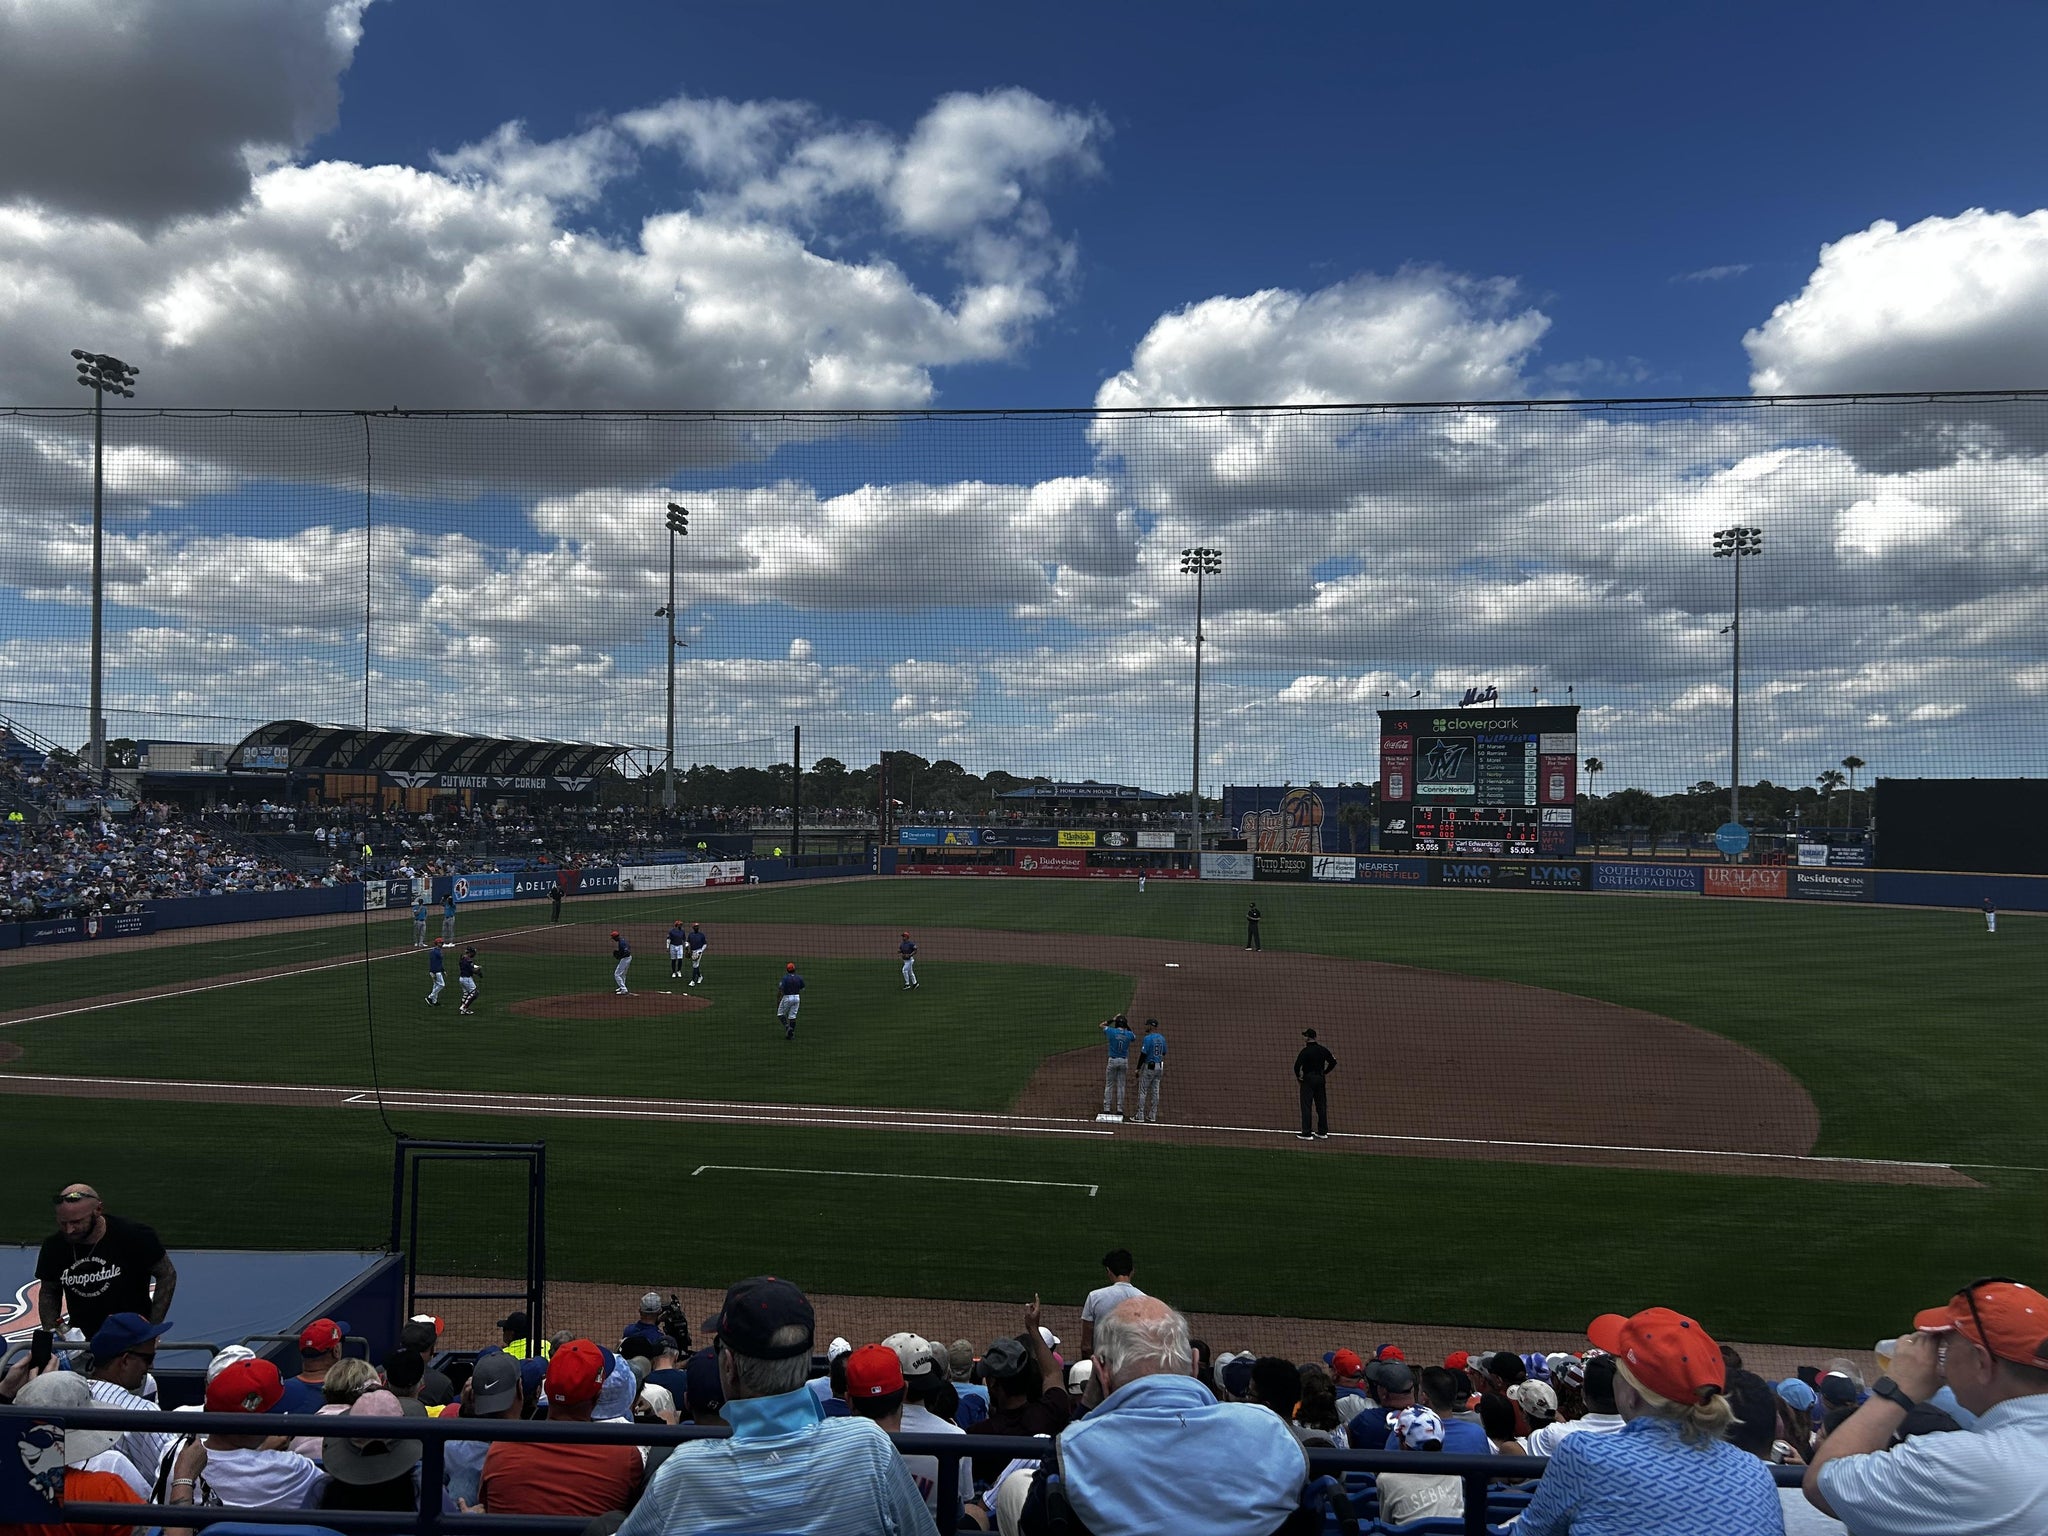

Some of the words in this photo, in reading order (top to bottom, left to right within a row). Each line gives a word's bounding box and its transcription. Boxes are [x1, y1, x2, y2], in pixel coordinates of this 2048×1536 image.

[1458, 685, 1498, 707] Mets
[441, 775, 488, 788] CUTWATER
[515, 776, 546, 789] CORNER
[1449, 812, 1455, 820] 0
[1499, 813, 1505, 821] 2
[1258, 829, 1311, 852] Mets
[1415, 843, 1439, 851] $5,055
[1510, 846, 1535, 854] $5,055
[1039, 856, 1081, 866] Budweiser
[1255, 856, 1279, 868] TUTTO
[1279, 857, 1306, 869] FRESCO
[1358, 862, 1399, 871] NEAREST
[1599, 865, 1639, 876] SOUTH
[1643, 867, 1694, 878] FLORIDA
[1359, 870, 1372, 878] TO
[1374, 870, 1392, 879] THE
[1393, 871, 1420, 880] FIELD
[1797, 873, 1850, 884] Residence
[525, 880, 557, 891] DELTA
[589, 876, 619, 886] DELTA
[1598, 875, 1696, 888] ORTHOPAEDICS
[57, 926, 76, 934] ULTRA
[59, 1264, 121, 1287] Aeropostale
